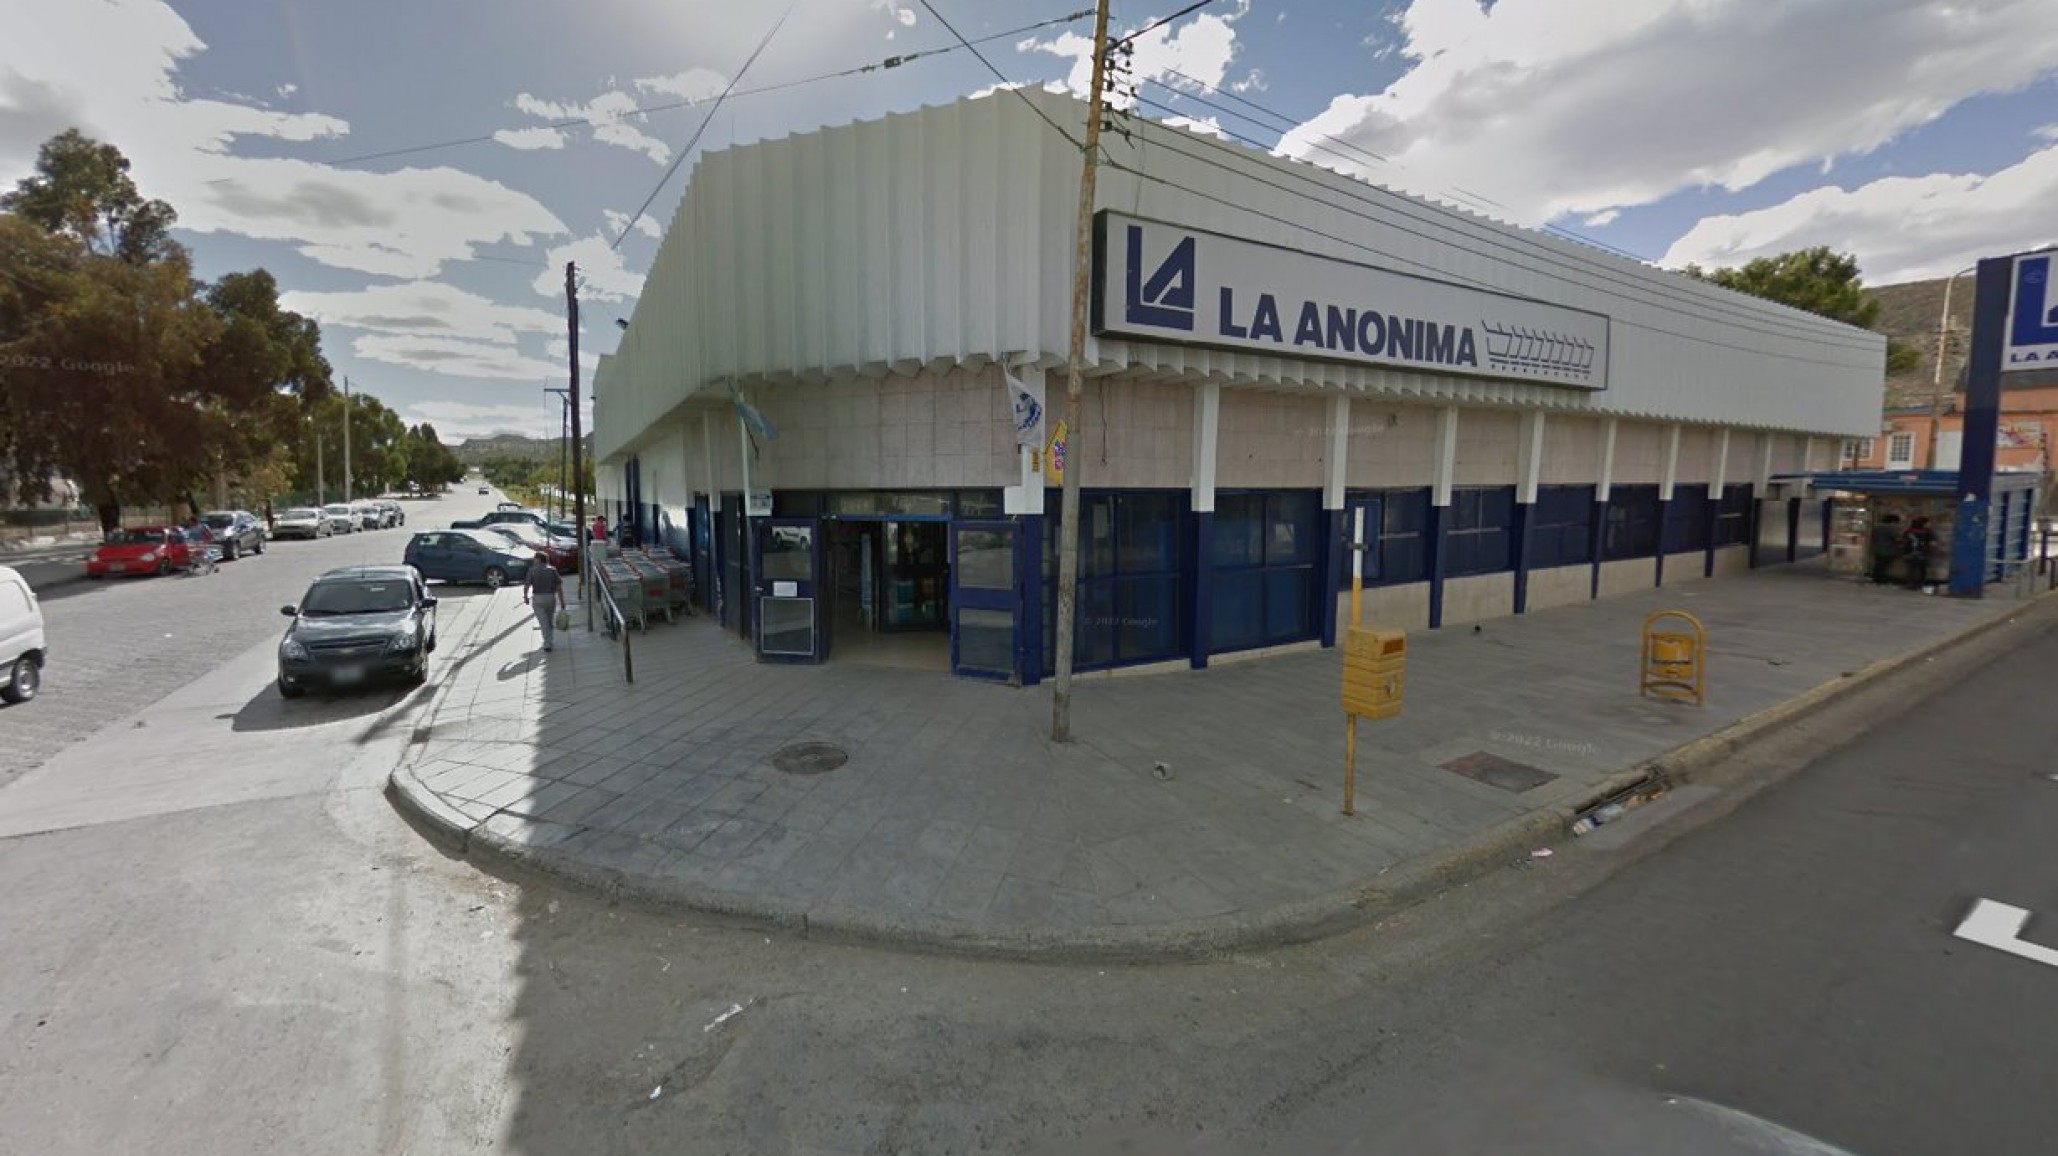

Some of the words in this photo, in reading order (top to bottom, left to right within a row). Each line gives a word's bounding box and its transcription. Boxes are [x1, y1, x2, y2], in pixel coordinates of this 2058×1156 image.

[1126, 225, 1195, 331] LA
[1219, 286, 1283, 343] LA
[1294, 301, 1478, 367] ANONIMA
[2010, 351, 2040, 363] LA
